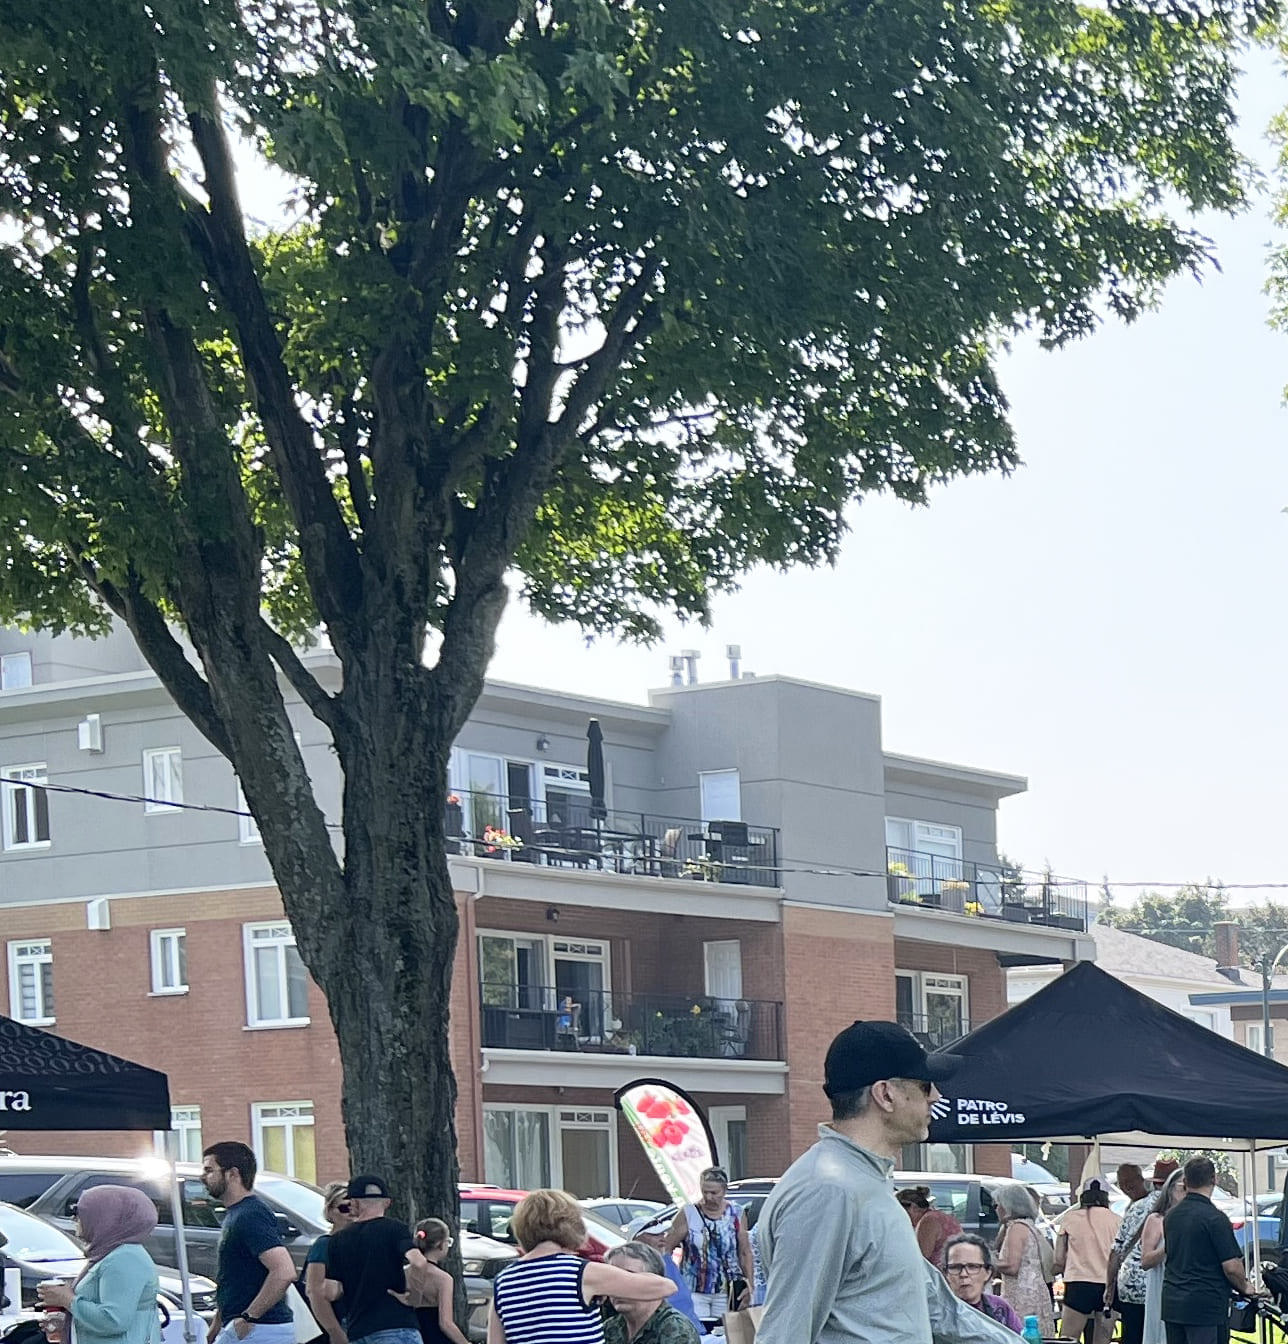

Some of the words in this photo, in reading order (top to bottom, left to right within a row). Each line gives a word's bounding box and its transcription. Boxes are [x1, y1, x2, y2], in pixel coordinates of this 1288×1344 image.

[956, 1098, 1008, 1111] PATRO
[957, 1114, 980, 1125] DE
[982, 1111, 1026, 1125] LÉVIS
